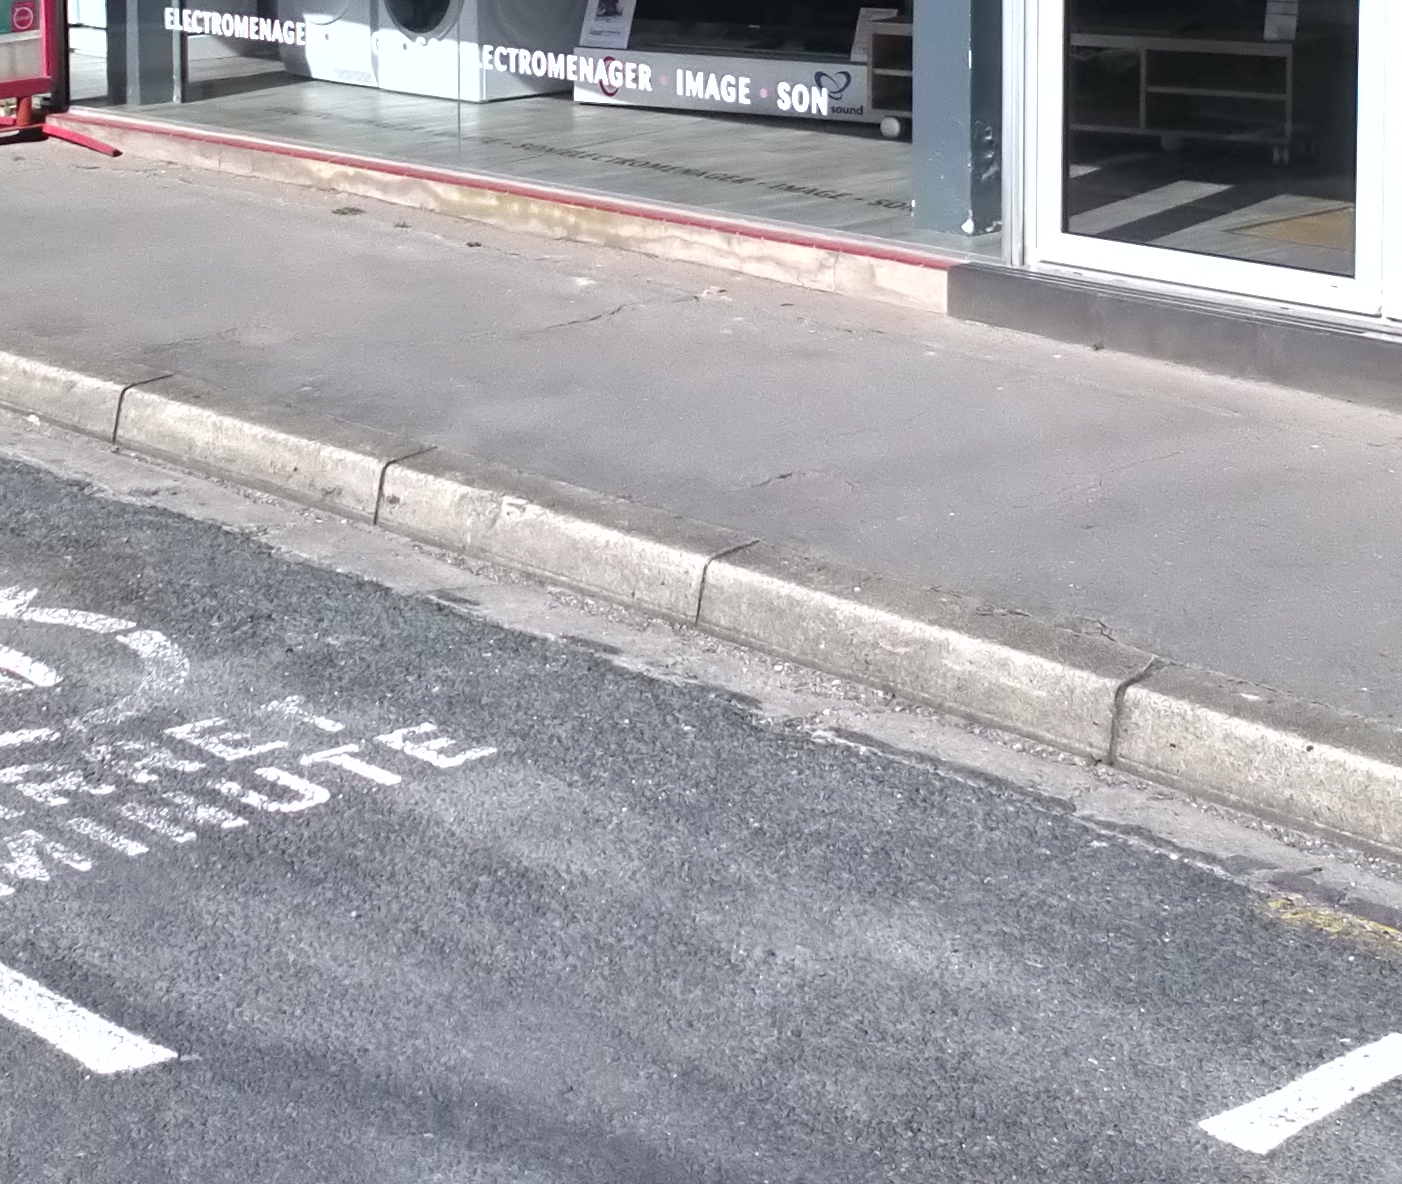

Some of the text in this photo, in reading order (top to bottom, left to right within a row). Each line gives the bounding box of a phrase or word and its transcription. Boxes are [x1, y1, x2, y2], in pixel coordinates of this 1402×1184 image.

[164, 7, 309, 46] ELECTROMENAGE
[473, 42, 653, 92] ECTROMENAGER
[676, 67, 751, 105] IMAGE
[776, 80, 828, 116] SON
[830, 103, 864, 117] sound
